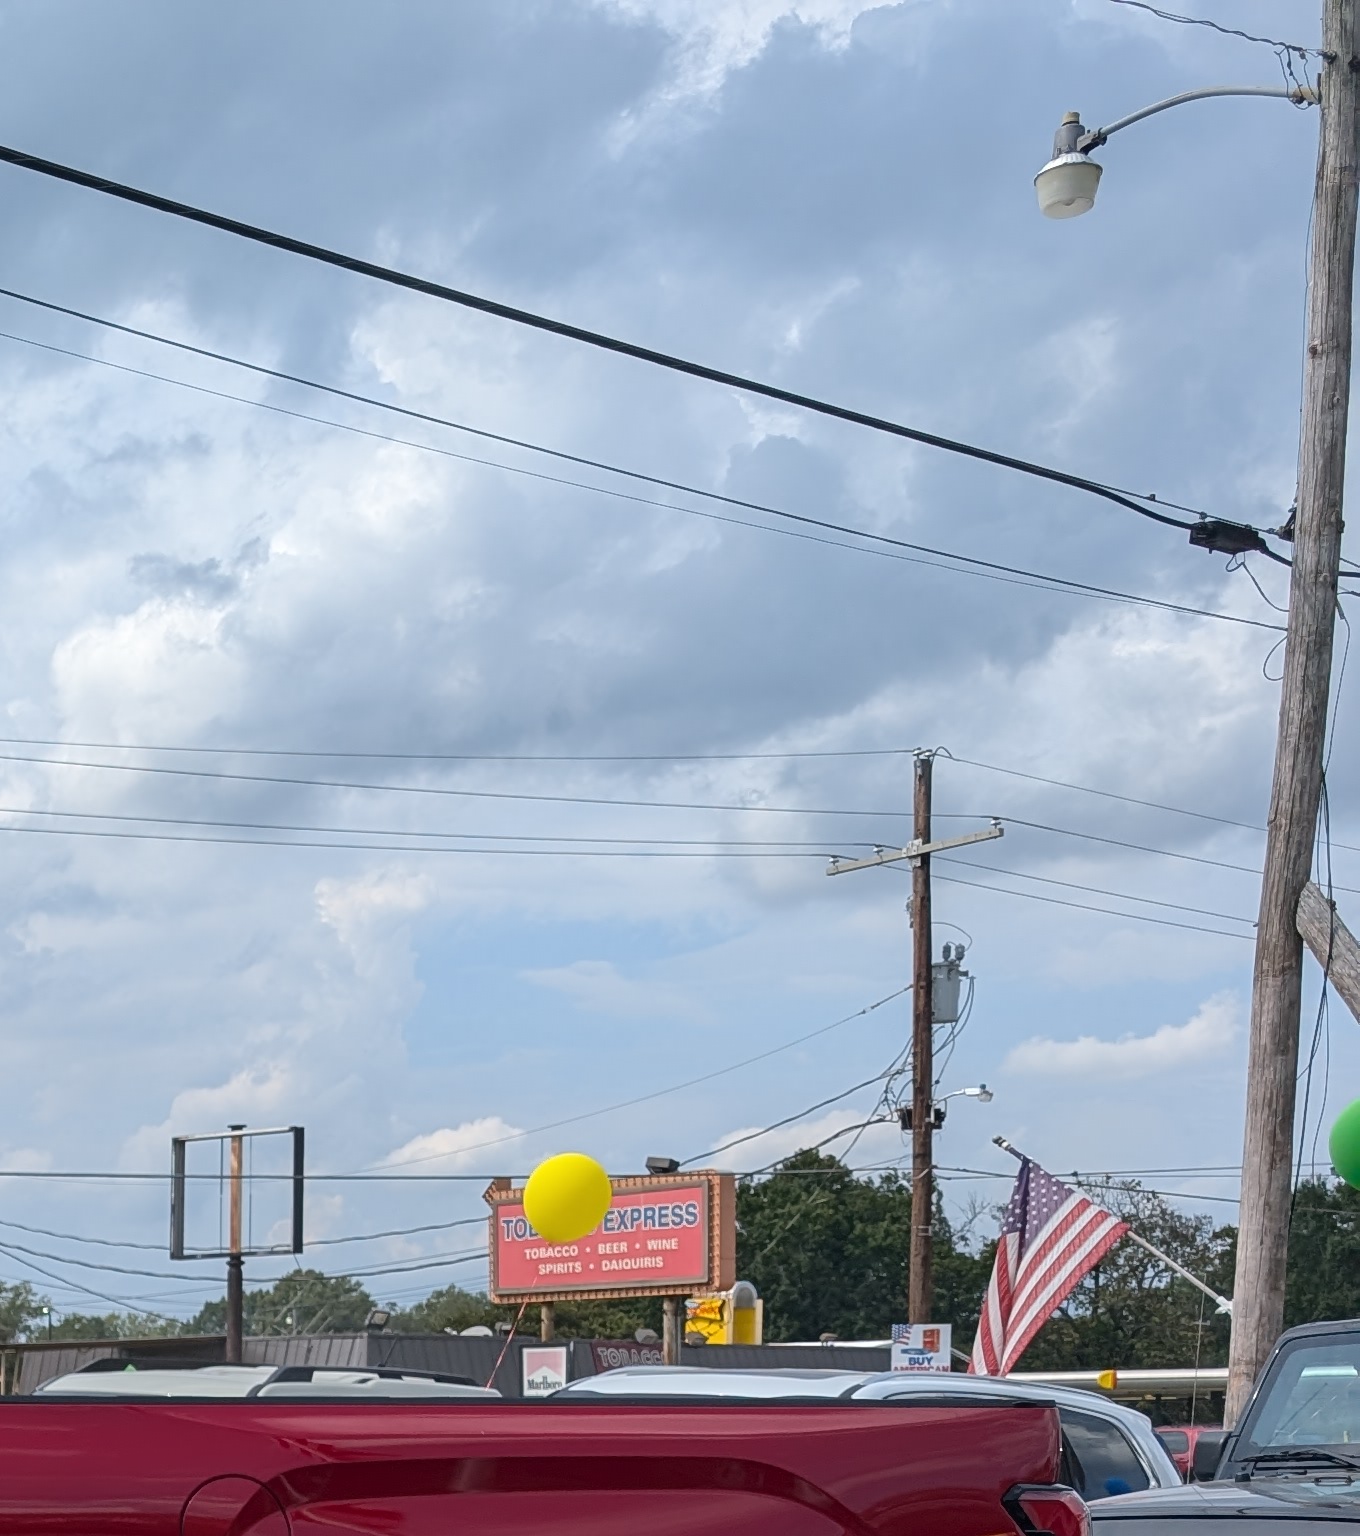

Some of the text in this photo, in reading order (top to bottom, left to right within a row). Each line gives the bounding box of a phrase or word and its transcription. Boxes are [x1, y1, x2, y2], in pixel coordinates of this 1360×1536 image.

[603, 1201, 699, 1234] EXPRESS
[524, 1238, 679, 1260] TOBACCO BEER WINE
[538, 1256, 664, 1275] SPIRITS DAIQUIRIS
[597, 1347, 666, 1368] TOBACC
[908, 1356, 934, 1366] BUY
[527, 1375, 563, 1391] Marlboro
